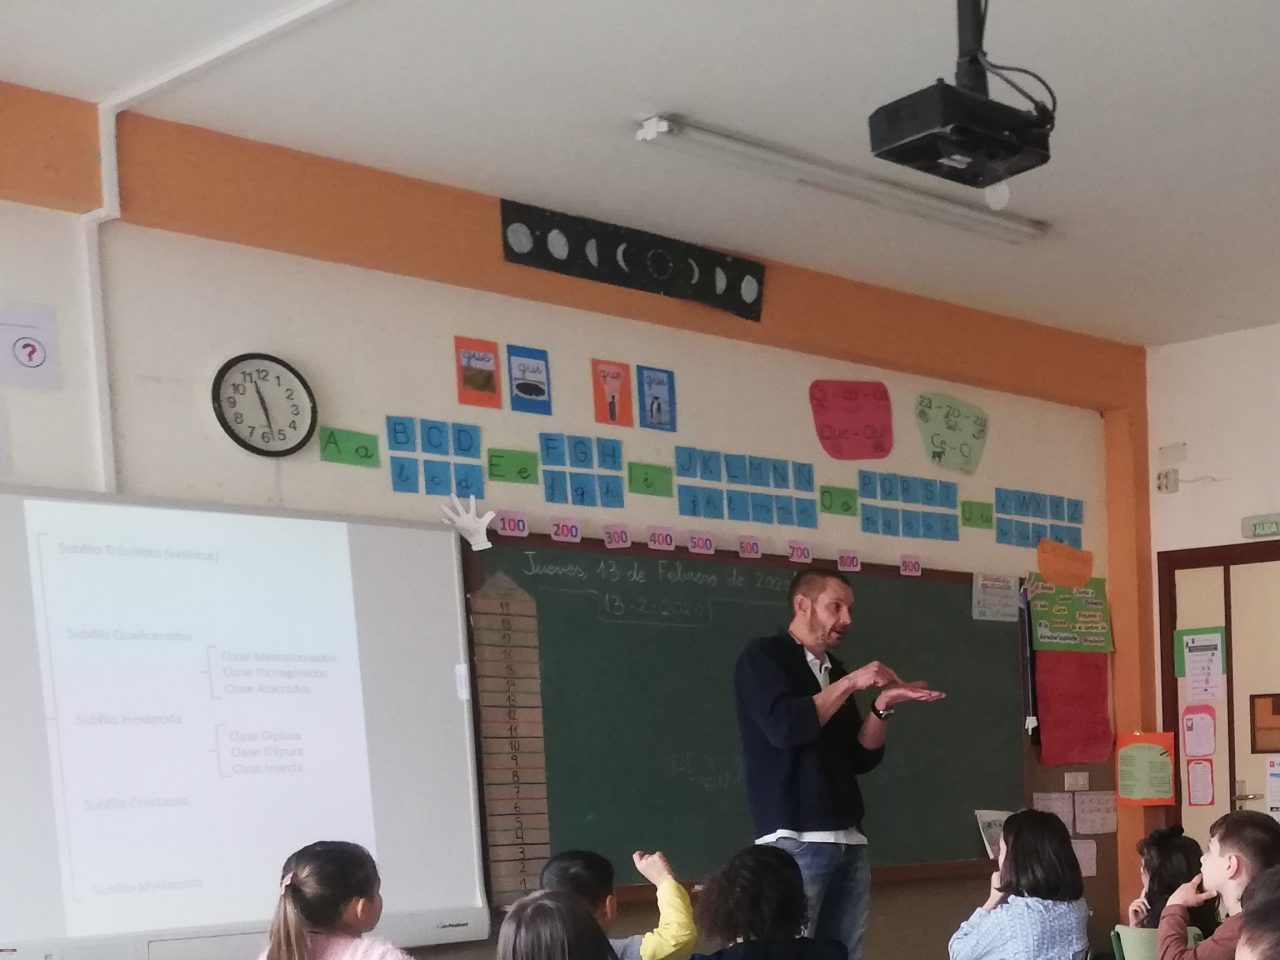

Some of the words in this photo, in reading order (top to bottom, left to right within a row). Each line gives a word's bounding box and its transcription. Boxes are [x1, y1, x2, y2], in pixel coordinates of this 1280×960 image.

[240, 371, 253, 384] 11
[255, 368, 269, 382] 12
[275, 375, 281, 387] 1
[231, 383, 246, 396] 10
[285, 388, 294, 400] 2
[227, 396, 237, 409] 9
[291, 404, 300, 416] 3
[234, 412, 244, 424] 8
[248, 426, 256, 438] 7
[288, 420, 297, 431] 4
[261, 432, 271, 444] 6
[278, 429, 287, 441] 5
[393, 421, 410, 445] B
[426, 426, 443, 449] C
[457, 429, 474, 452] D
[322, 430, 341, 454] A
[544, 438, 558, 458] F
[574, 441, 588, 463] G
[602, 445, 616, 466] H
[489, 454, 505, 479] E
[517, 465, 532, 480] e
[679, 452, 692, 472] J
[820, 490, 833, 510] O
[841, 500, 853, 512] o
[963, 502, 973, 522] U
[500, 517, 526, 532] 100
[553, 524, 578, 538] 200
[605, 531, 628, 545] 300
[650, 532, 673, 547] 400
[690, 536, 712, 550] 500
[740, 541, 760, 555] 600
[788, 546, 810, 559] 700
[839, 555, 859, 568] 800
[902, 561, 920, 572] 900
[597, 561, 620, 582] 13
[627, 562, 646, 583] de
[658, 560, 718, 586] Febrero
[726, 565, 745, 587] de
[221, 651, 251, 662] Clase
[223, 667, 252, 678] Clase
[224, 683, 254, 694] Clase
[229, 730, 259, 742] Clase
[507, 724, 518, 737] 11
[230, 746, 260, 758] Clase
[509, 741, 520, 752] 10
[511, 754, 518, 768] 9
[232, 763, 262, 774] Clase
[512, 770, 520, 784] 8
[515, 827, 524, 844] 4
[519, 846, 526, 860] 3
[518, 861, 527, 874] 2
